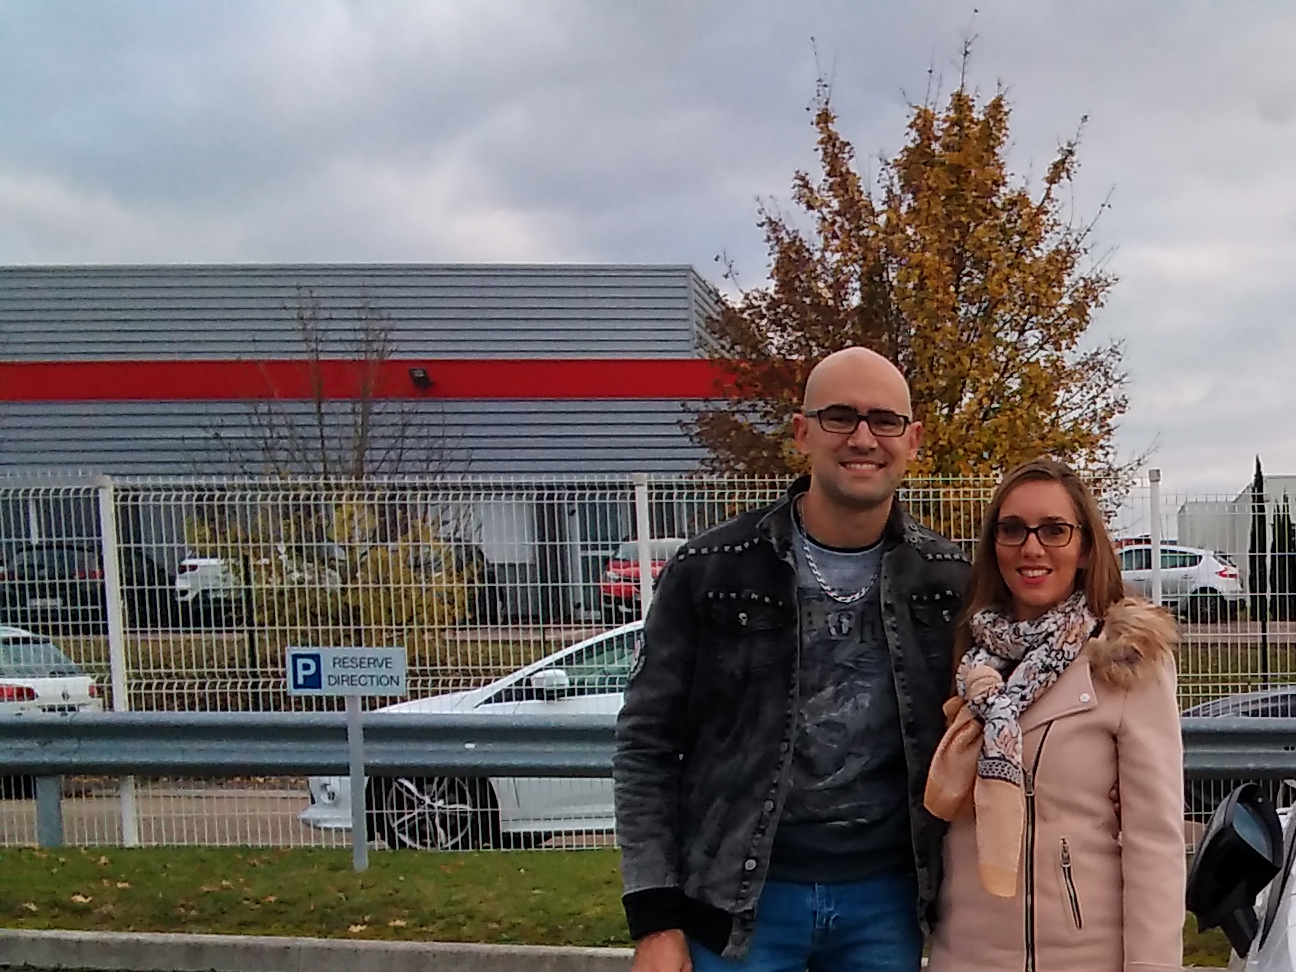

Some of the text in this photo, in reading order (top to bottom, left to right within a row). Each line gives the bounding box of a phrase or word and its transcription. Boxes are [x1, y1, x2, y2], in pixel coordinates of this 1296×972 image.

[332, 657, 393, 669] RESERVE
[297, 658, 317, 685] P
[328, 674, 399, 687] DIRECTION
